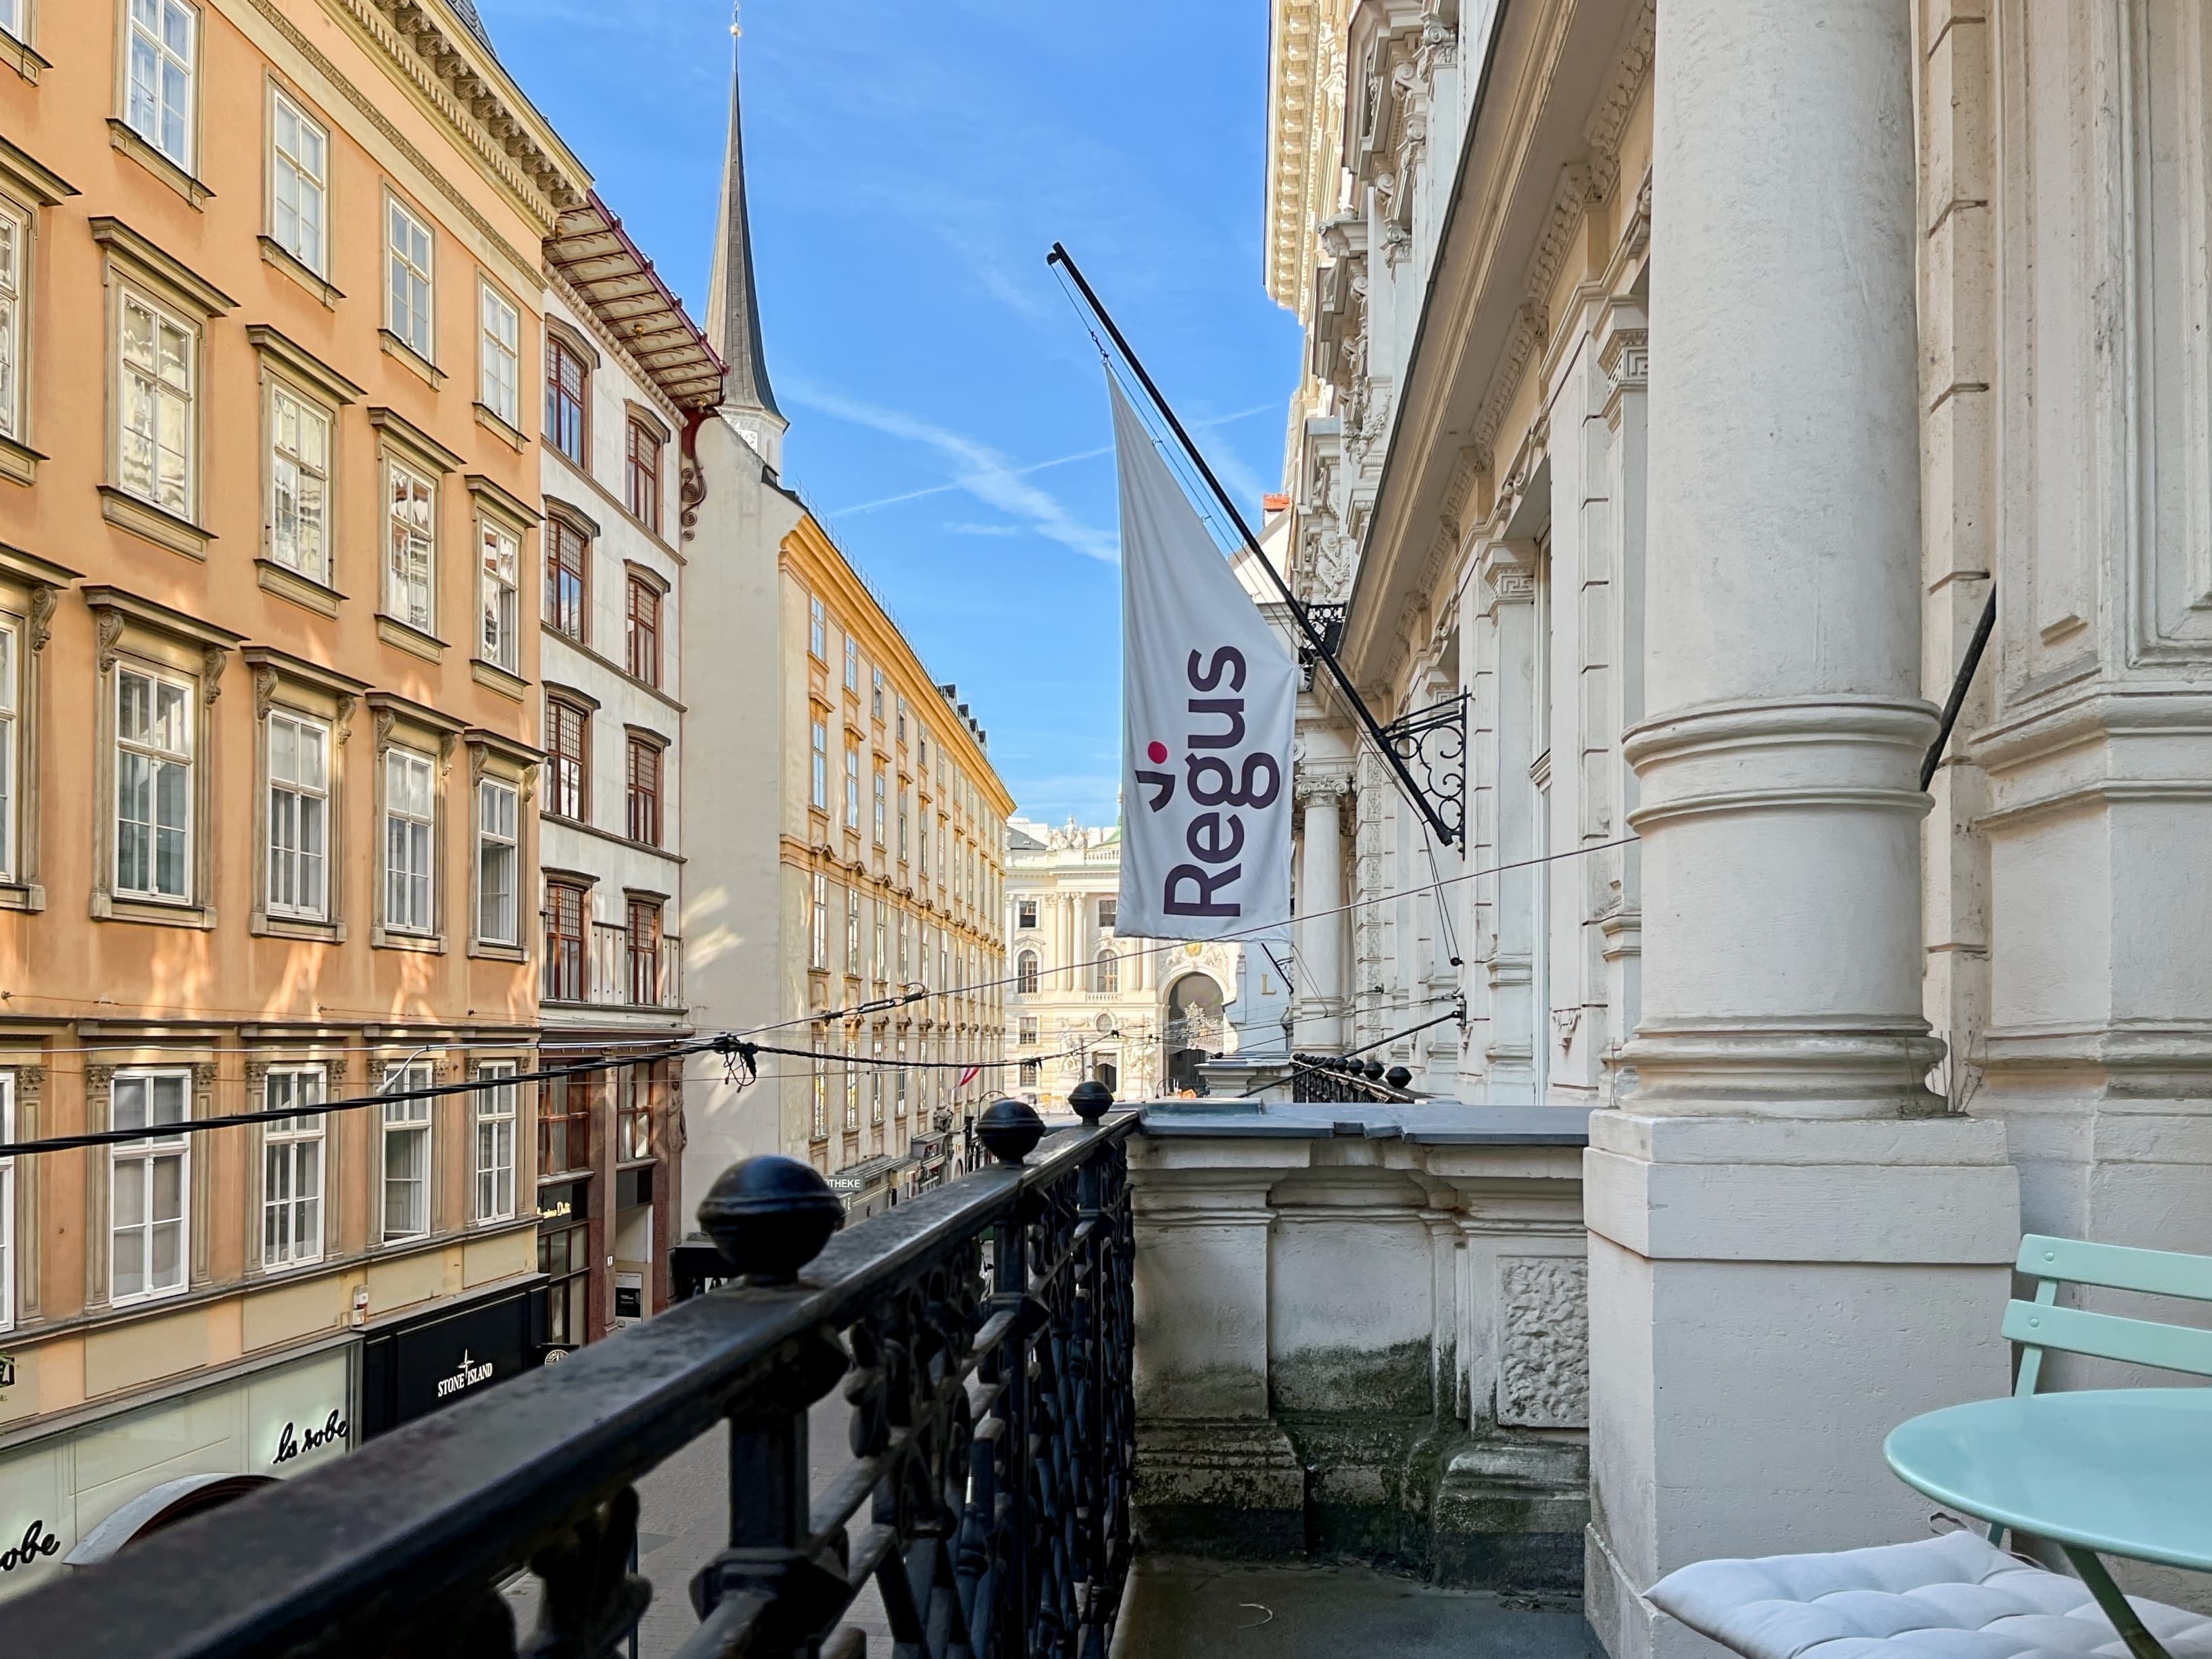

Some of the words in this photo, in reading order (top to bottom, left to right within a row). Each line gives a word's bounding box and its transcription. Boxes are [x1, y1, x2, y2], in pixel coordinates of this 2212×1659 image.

[1163, 646, 1280, 917] Regus
[438, 1373, 464, 1397] STONE
[467, 1363, 493, 1386] ISLAND
[272, 1422, 297, 1464] la
[301, 1409, 348, 1453] robe
[0, 1520, 60, 1571] obe
